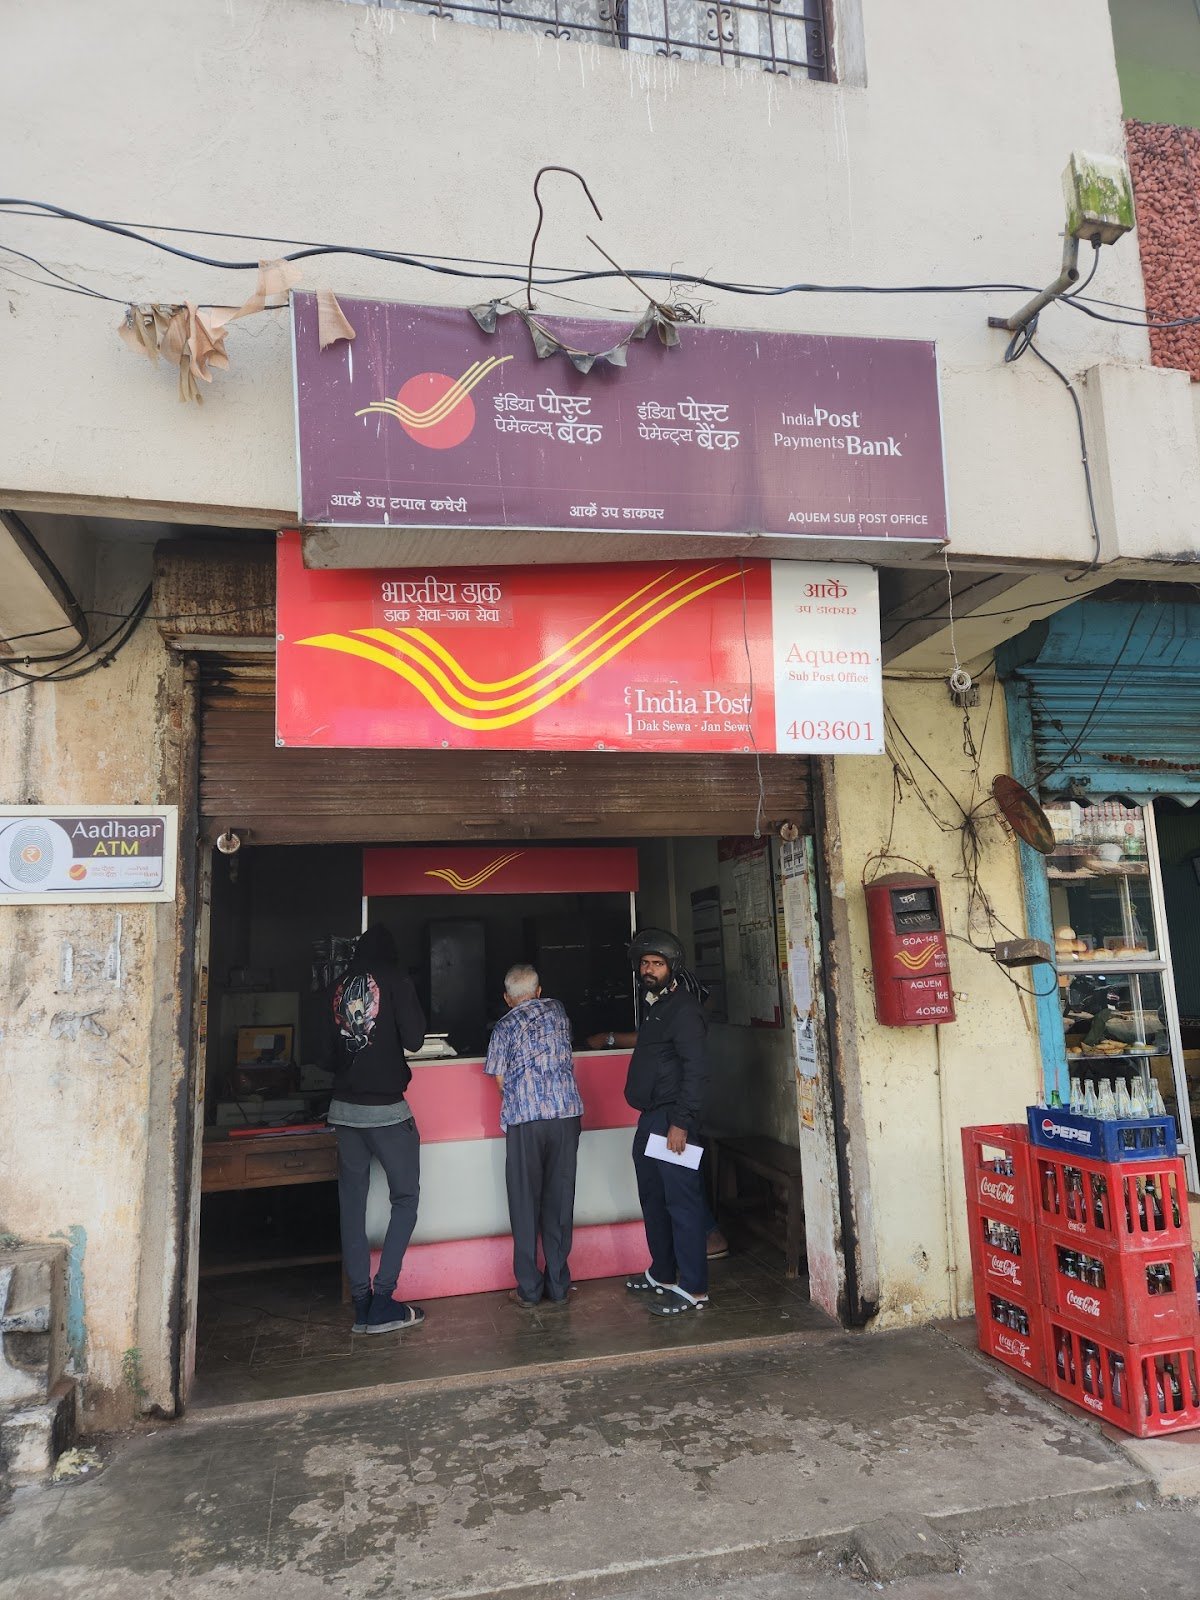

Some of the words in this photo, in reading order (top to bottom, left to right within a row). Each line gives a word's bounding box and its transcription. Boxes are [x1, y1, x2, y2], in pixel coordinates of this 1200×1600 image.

[493, 392, 535, 412] इंडिया
[536, 388, 592, 415] पोस्ट
[637, 401, 676, 420] इंडिया
[677, 396, 729, 422] पोस्ट
[555, 415, 603, 444] बँक
[695, 422, 740, 450] बैंक
[366, 496, 386, 508] उप
[390, 497, 426, 511] टपाल
[430, 496, 467, 512] कचेरी
[601, 507, 619, 518] उप
[622, 508, 664, 520] डाकघर
[788, 512, 831, 524] AQUEM
[834, 513, 856, 524] SUB
[859, 513, 888, 524] POST
[890, 514, 928, 525] OFFICE
[381, 575, 457, 604] भारतीय
[461, 582, 502, 604] डाक
[803, 578, 848, 599] आकें
[383, 609, 411, 622] डाक
[475, 604, 501, 622] सेवा
[785, 643, 872, 668] Aquem
[788, 671, 809, 682] Sub
[812, 671, 835, 683] Post
[838, 671, 869, 683] Office
[635, 689, 699, 714] India
[702, 690, 752, 714] Post
[637, 719, 660, 731] Dak
[662, 720, 691, 732] Sewa
[701, 720, 722, 732] Jan
[785, 720, 874, 742] 403601
[71, 821, 161, 839] Aadhaar
[92, 840, 139, 856] ATM
[910, 980, 942, 989] AQUEM
[915, 1006, 949, 1016] 403601
[1052, 1124, 1092, 1144] PEPSI
